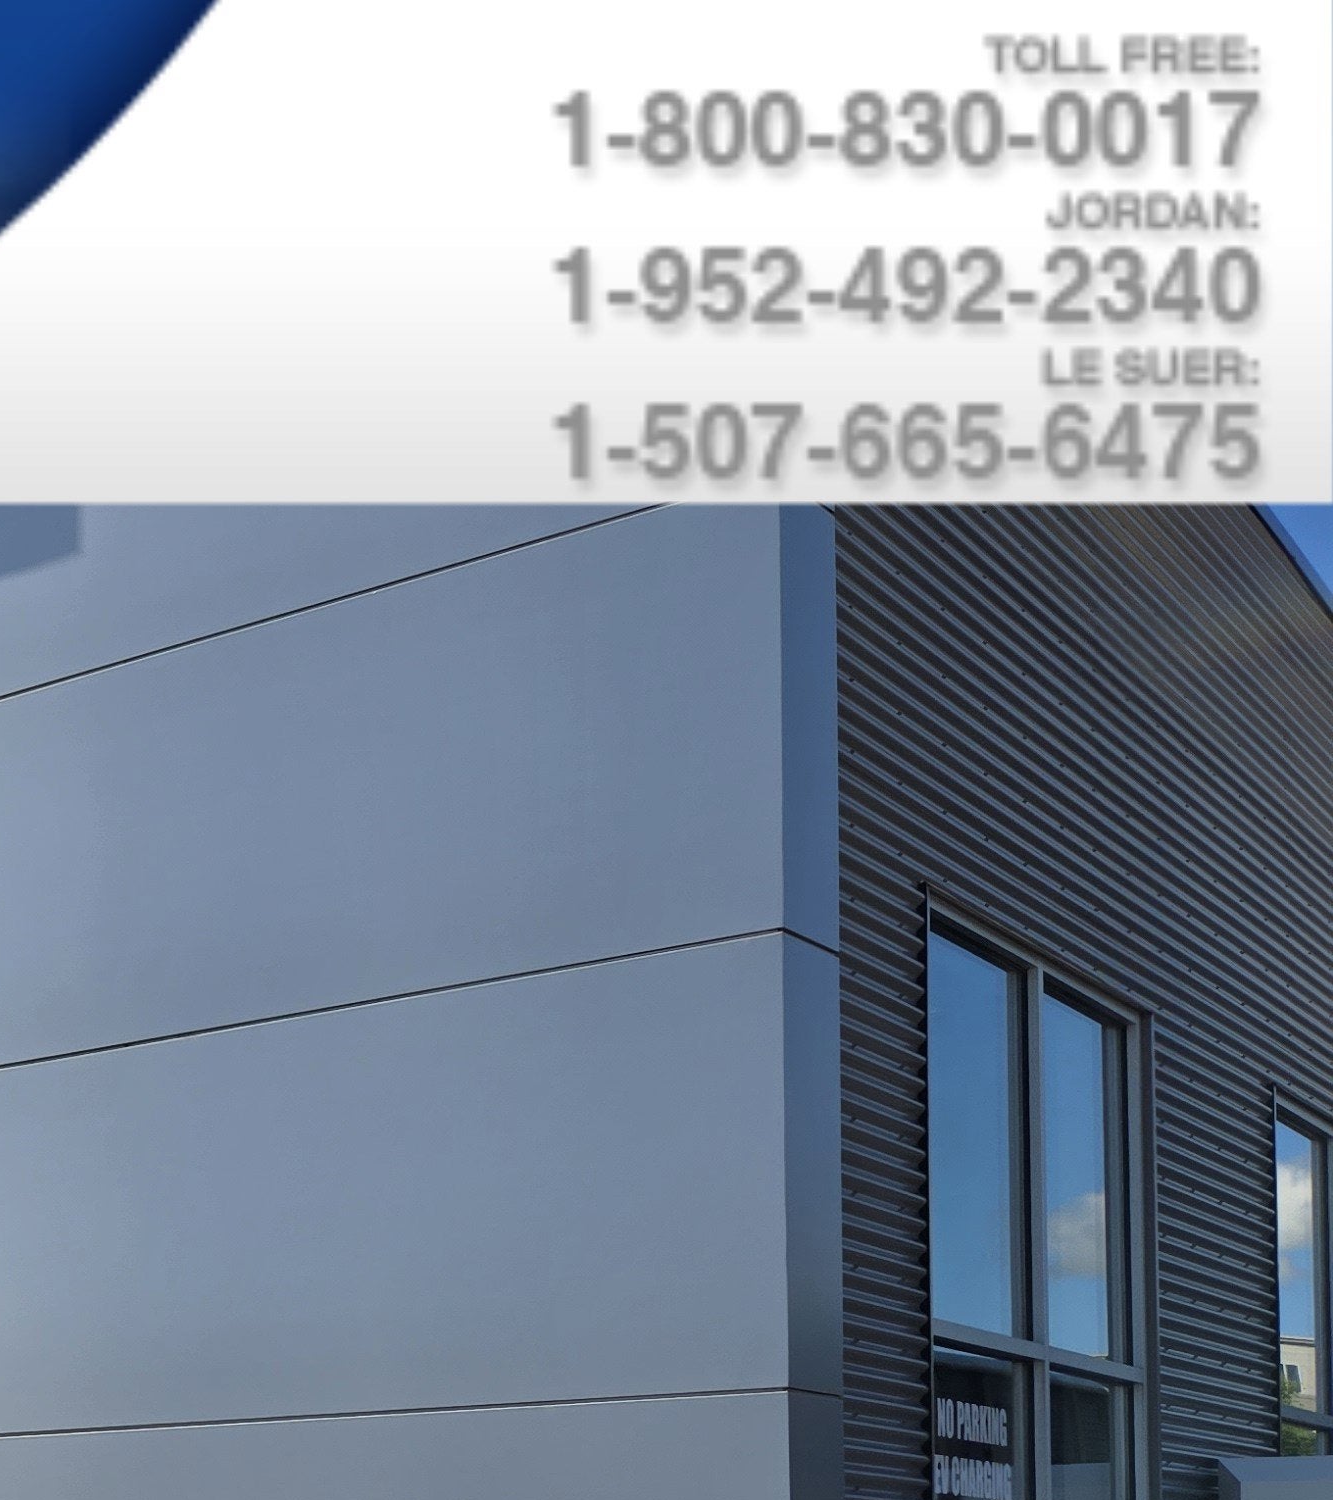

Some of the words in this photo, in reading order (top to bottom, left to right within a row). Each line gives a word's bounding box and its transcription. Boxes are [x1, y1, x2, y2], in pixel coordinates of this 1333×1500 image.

[937, 1397, 955, 1438] NO
[956, 1401, 1008, 1447] PARKING
[934, 1454, 950, 1494] EV
[951, 1456, 1012, 1500] CHARGING
